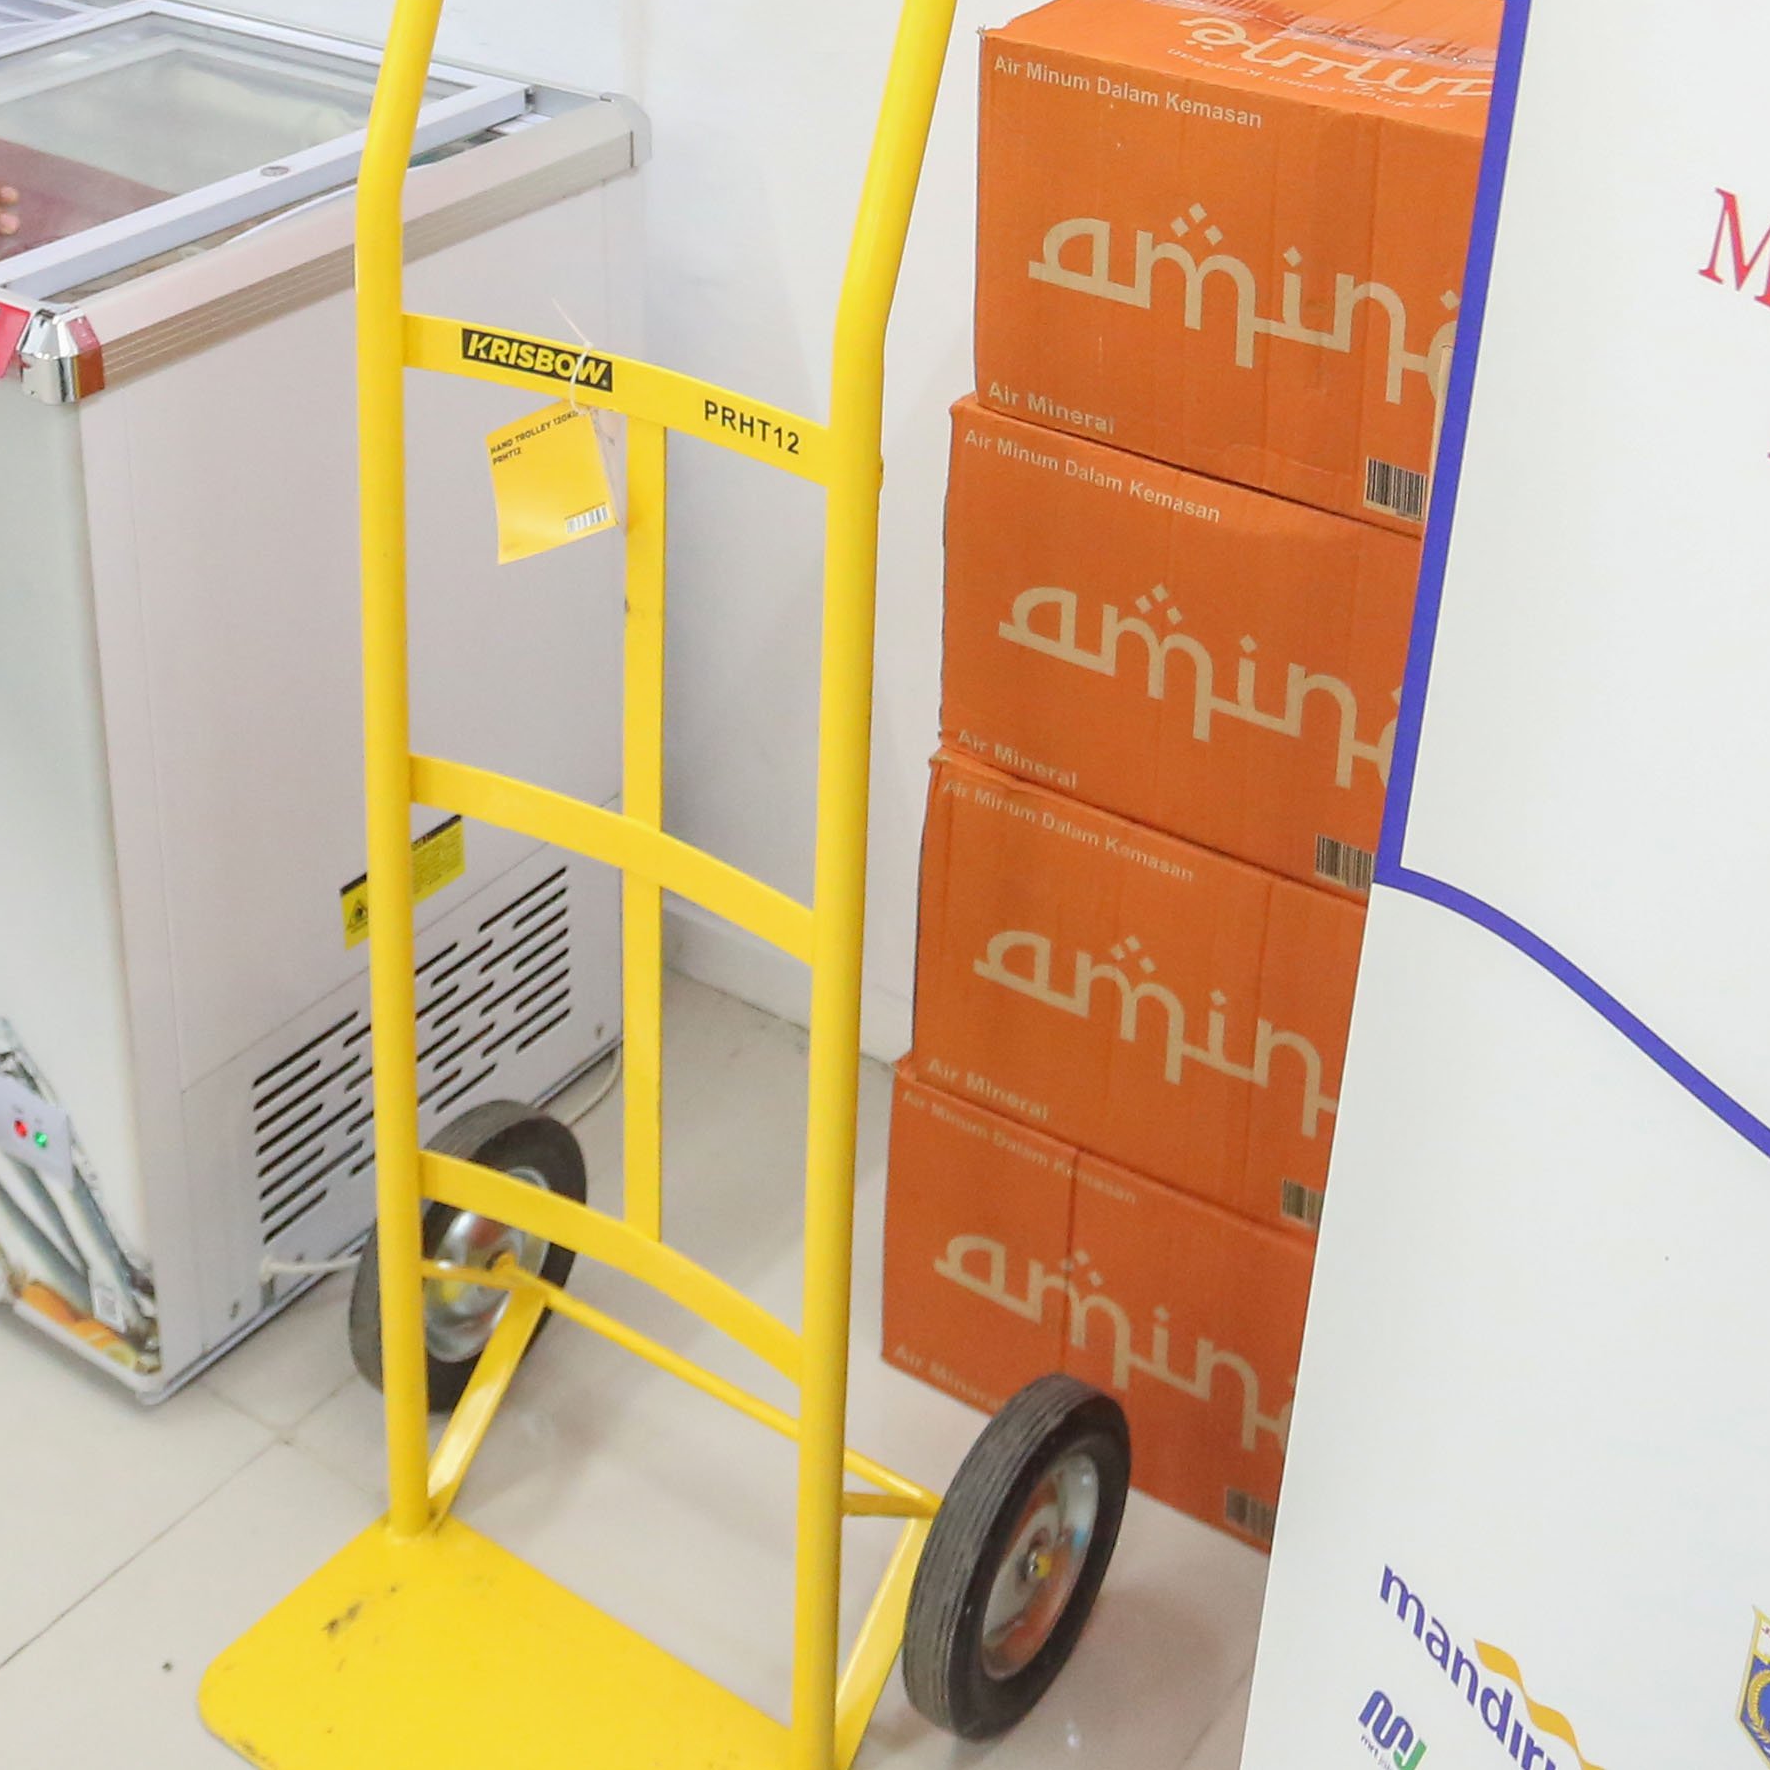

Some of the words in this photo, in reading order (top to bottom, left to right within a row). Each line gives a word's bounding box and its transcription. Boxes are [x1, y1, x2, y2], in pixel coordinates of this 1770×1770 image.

[994, 54, 1020, 75] Air
[1026, 61, 1091, 92] Minum
[1097, 76, 1159, 108] Dalam
[1165, 92, 1262, 129] Kemasan
[467, 332, 609, 386] KRISBOW
[490, 438, 513, 455] HAND
[515, 421, 551, 443] TROLLEY
[704, 399, 801, 455] PRHT12
[988, 382, 1020, 406] Air
[1028, 391, 1115, 435] Mineral
[492, 447, 522, 465] PRHT12
[964, 428, 992, 450] Air
[997, 437, 1059, 473] Minum
[1064, 457, 1123, 493] Dalam
[1129, 479, 1221, 524] Kemasan
[957, 729, 987, 754] Air
[994, 743, 1079, 790] Mineral
[942, 779, 969, 801] Air
[974, 787, 1037, 826] Minum
[1041, 810, 1099, 847] Dalam
[1105, 833, 1195, 882] Kemasan
[972, 929, 1339, 1139] amin
[928, 1057, 959, 1083] Air
[966, 1071, 1050, 1122] Mineral
[993, 1129, 1049, 1168] Dalam
[1053, 1152, 1137, 1205] Kemasan
[933, 1232, 1295, 1452] amin
